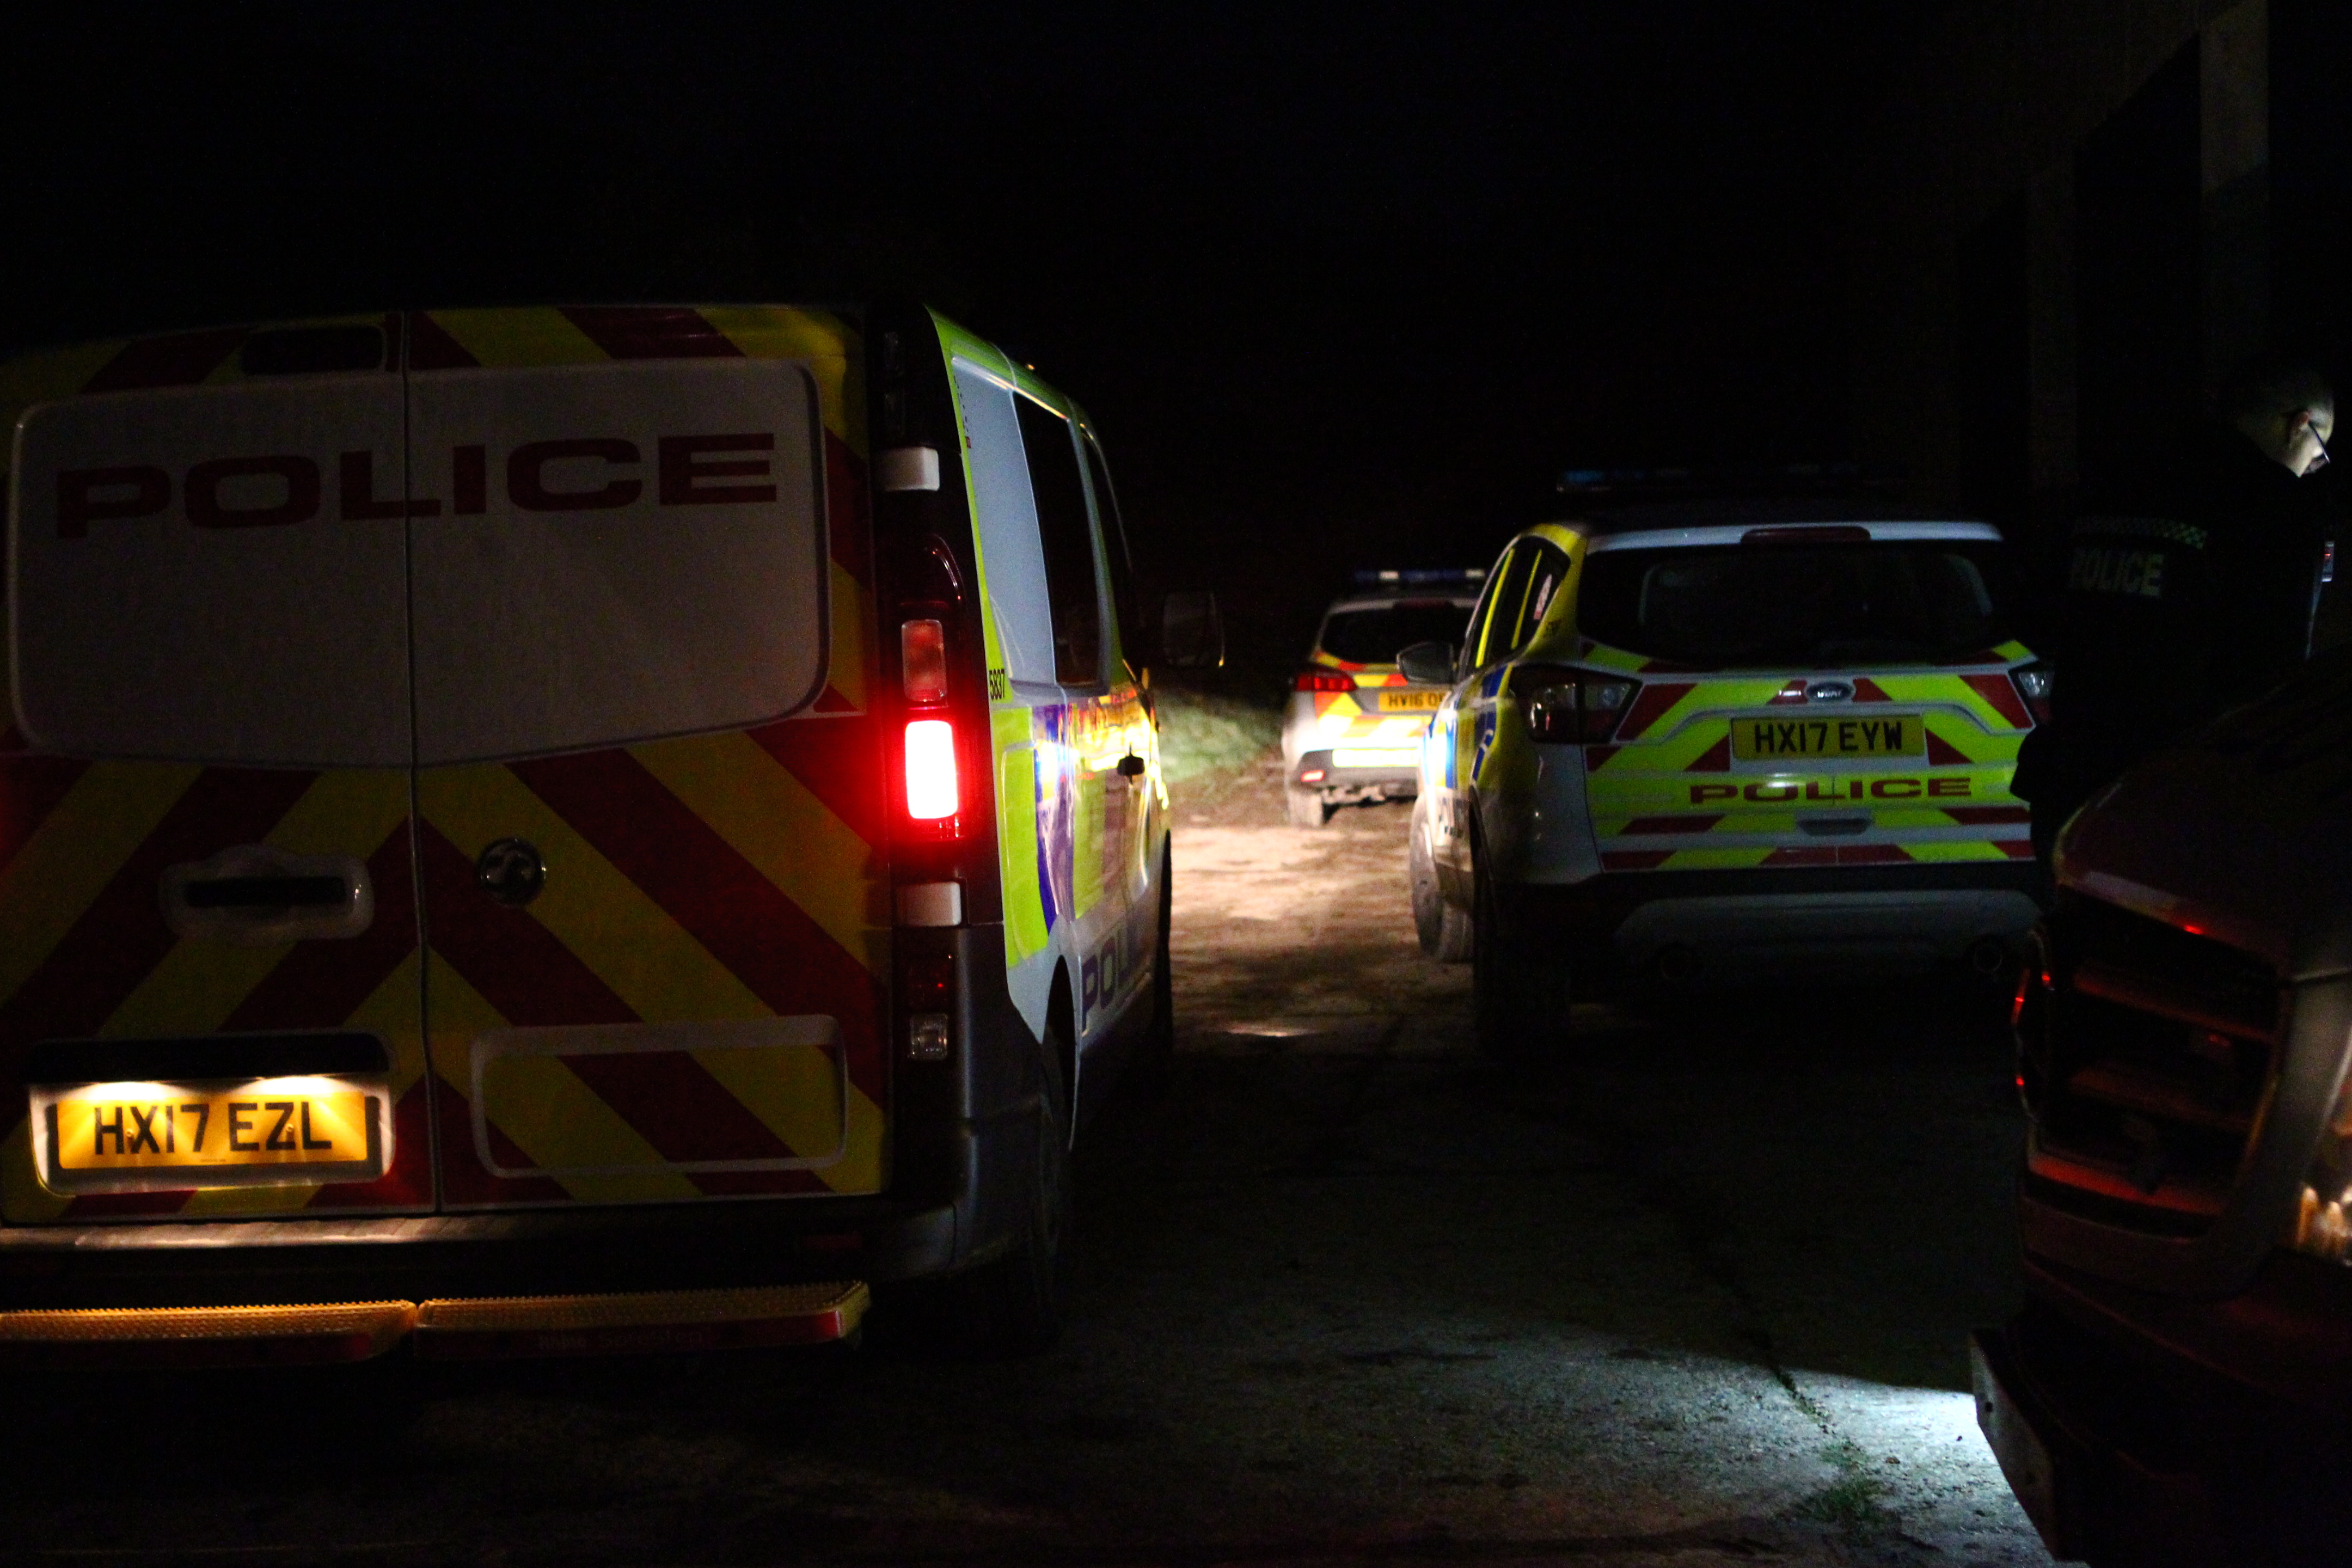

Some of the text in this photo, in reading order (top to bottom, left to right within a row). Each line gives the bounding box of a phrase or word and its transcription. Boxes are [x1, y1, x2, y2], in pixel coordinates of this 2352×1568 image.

[56, 433, 777, 538] POLICE
[2066, 547, 2165, 597] POLICE
[1754, 721, 1903, 753] HX17 EYW
[1689, 777, 1973, 804] POLICE
[94, 1101, 333, 1156] HX17 EZL
